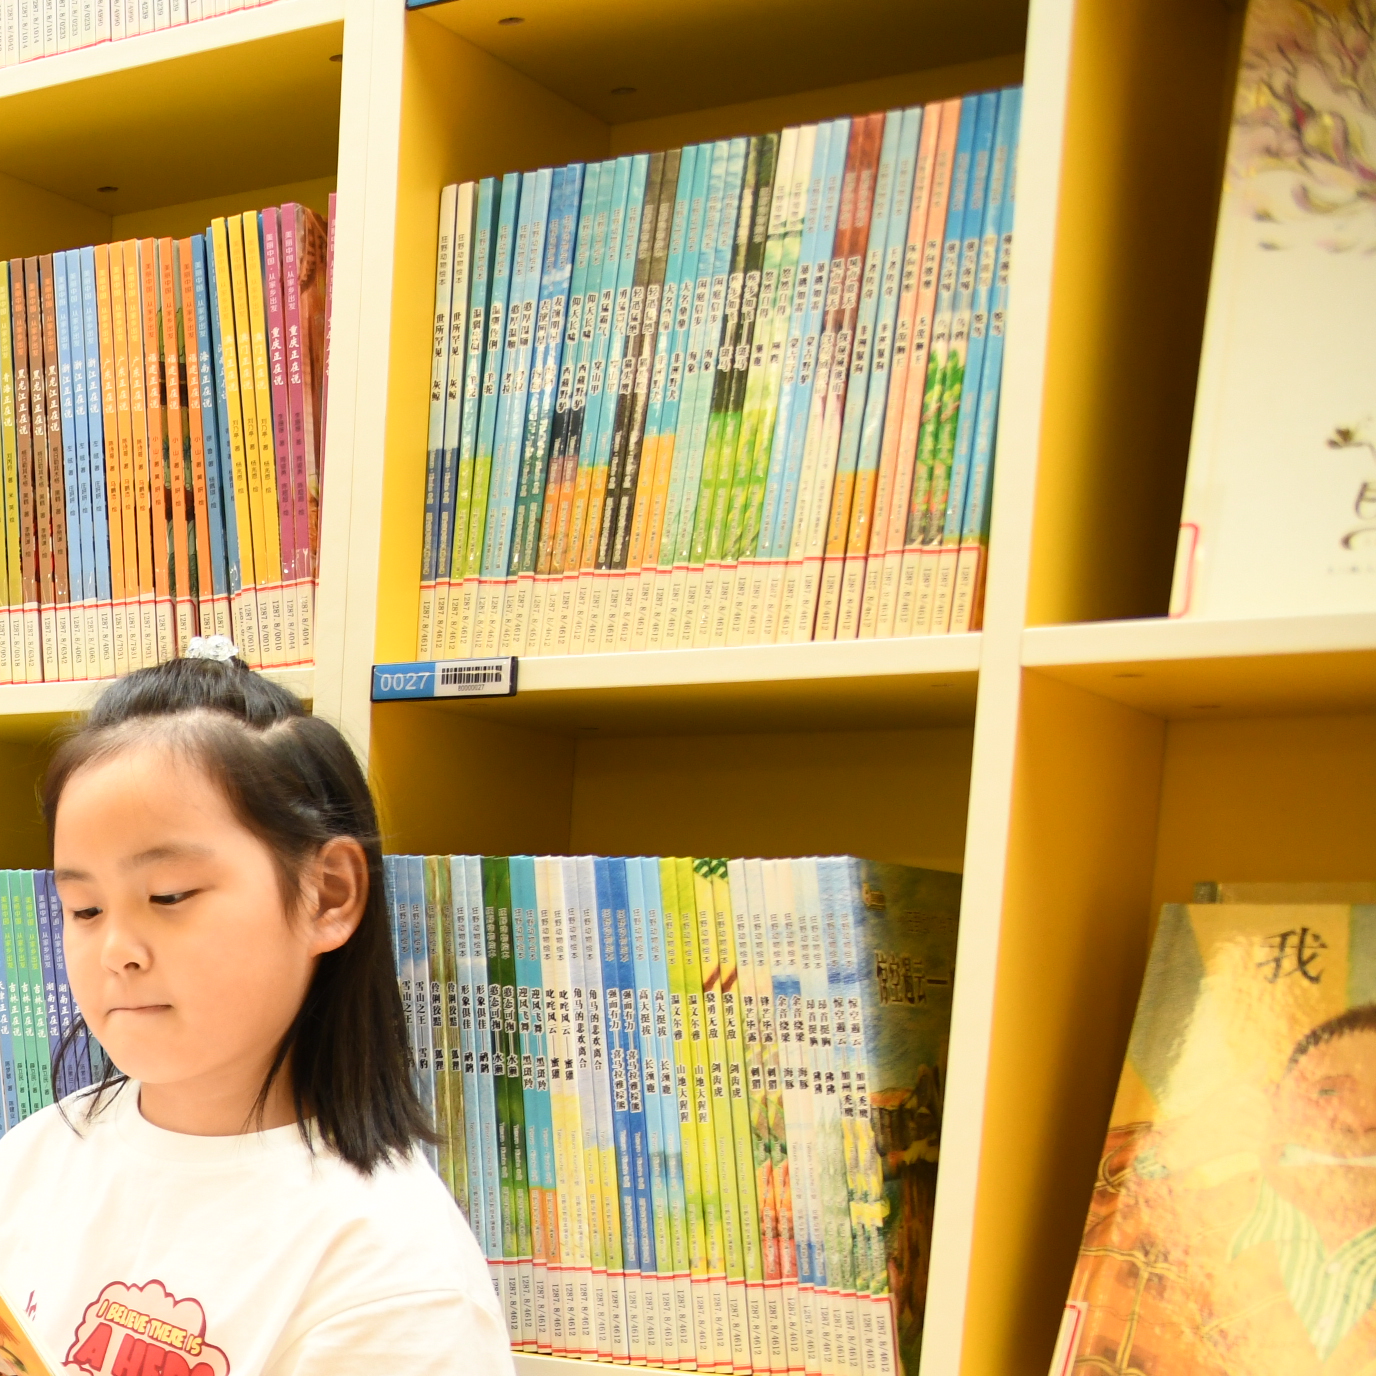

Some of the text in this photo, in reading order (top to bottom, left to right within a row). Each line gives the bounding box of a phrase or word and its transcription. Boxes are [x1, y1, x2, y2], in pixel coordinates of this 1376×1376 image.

[271, 327, 284, 386] 重庆正在说
[289, 325, 301, 384] 重庆正在说
[2, 373, 12, 426] 青海正在说
[17, 369, 28, 435] 黑龙江正在说
[32, 370, 43, 436] 黑龙江正在说
[49, 365, 60, 431] 黑龙江正在说
[380, 671, 430, 692] 0027
[1255, 926, 1328, 985] 我
[9, 983, 21, 1036] 吉林正在说
[21, 982, 34, 1036] 吉林正在说
[34, 984, 46, 1038] 吉林正在说
[73, 1322, 112, 1371] A
[97, 1299, 203, 1356] I BELIEVE THERE IS
